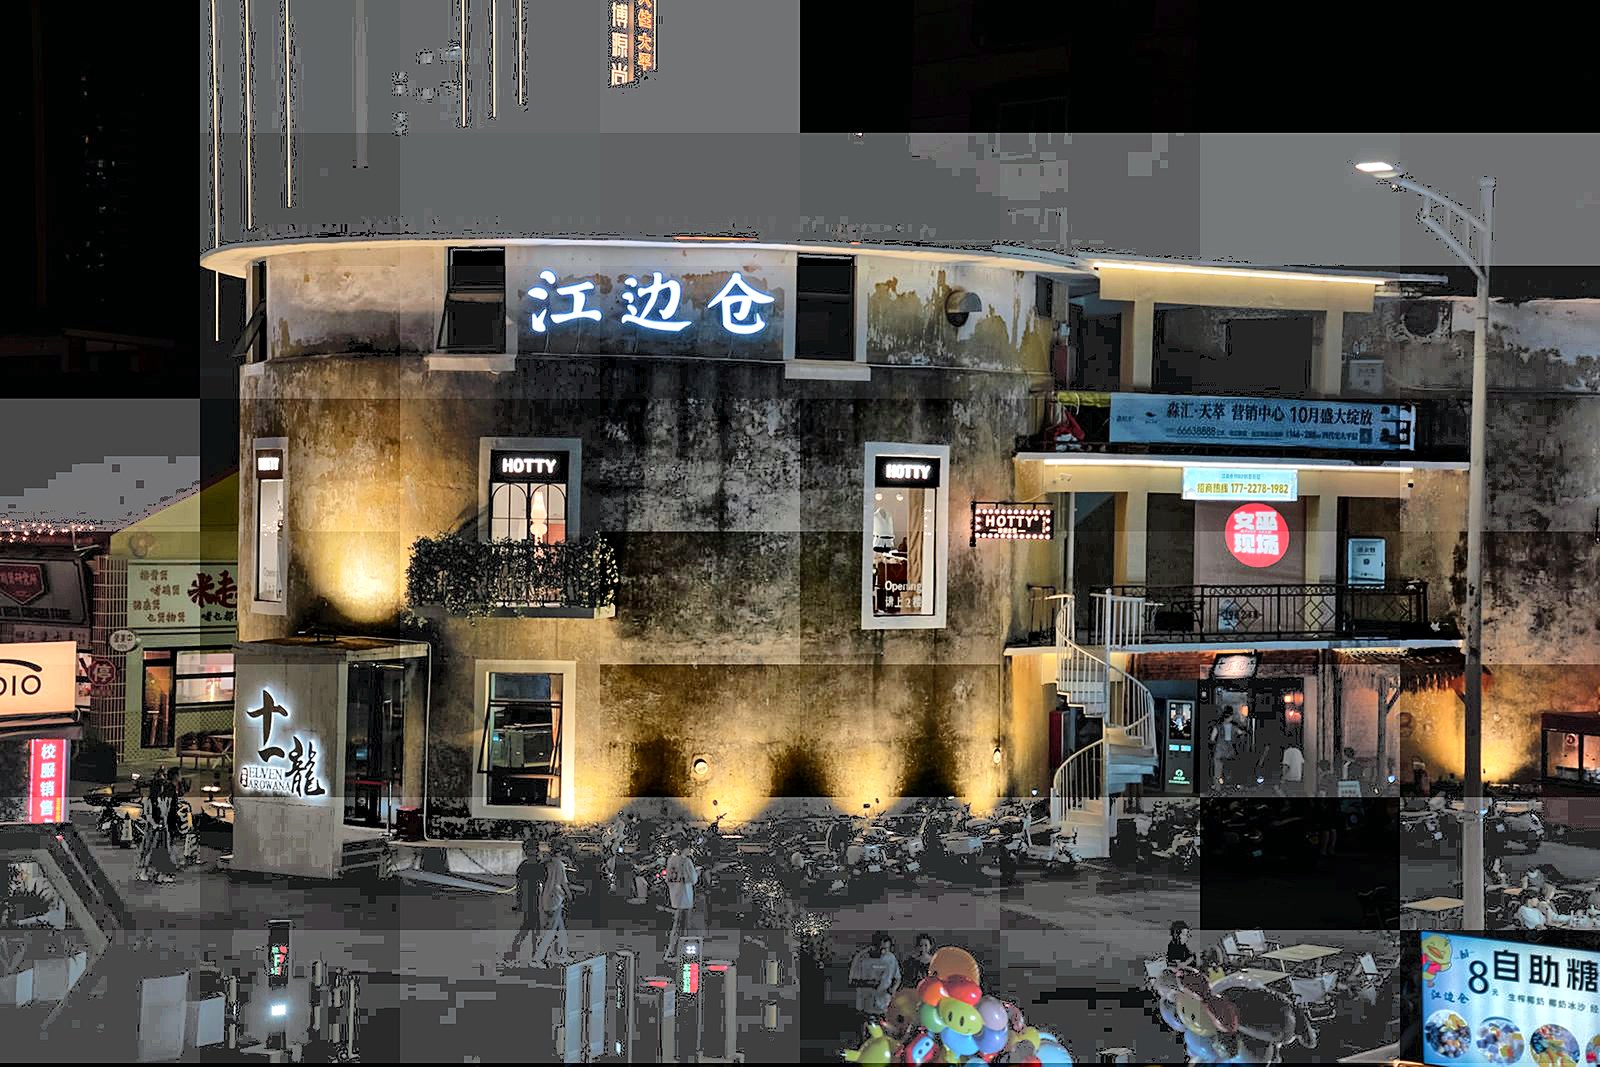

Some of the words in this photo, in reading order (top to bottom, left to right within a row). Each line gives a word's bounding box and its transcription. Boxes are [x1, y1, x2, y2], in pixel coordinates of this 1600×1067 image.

[527, 270, 776, 335] 江边仓
[1290, 406, 1373, 426] 10月盛大绽放
[502, 458, 557, 474] HOTTY
[885, 463, 931, 480] HOTTY
[1231, 483, 1289, 494] 177-2278-1982
[985, 515, 1034, 528] HOTTY
[1234, 533, 1280, 555] 现场
[885, 580, 923, 593] Opening
[92, 664, 112, 682] 停
[39, 743, 57, 823] 校服销售
[247, 779, 292, 792] AROWANA
[1468, 960, 1489, 994] 8
